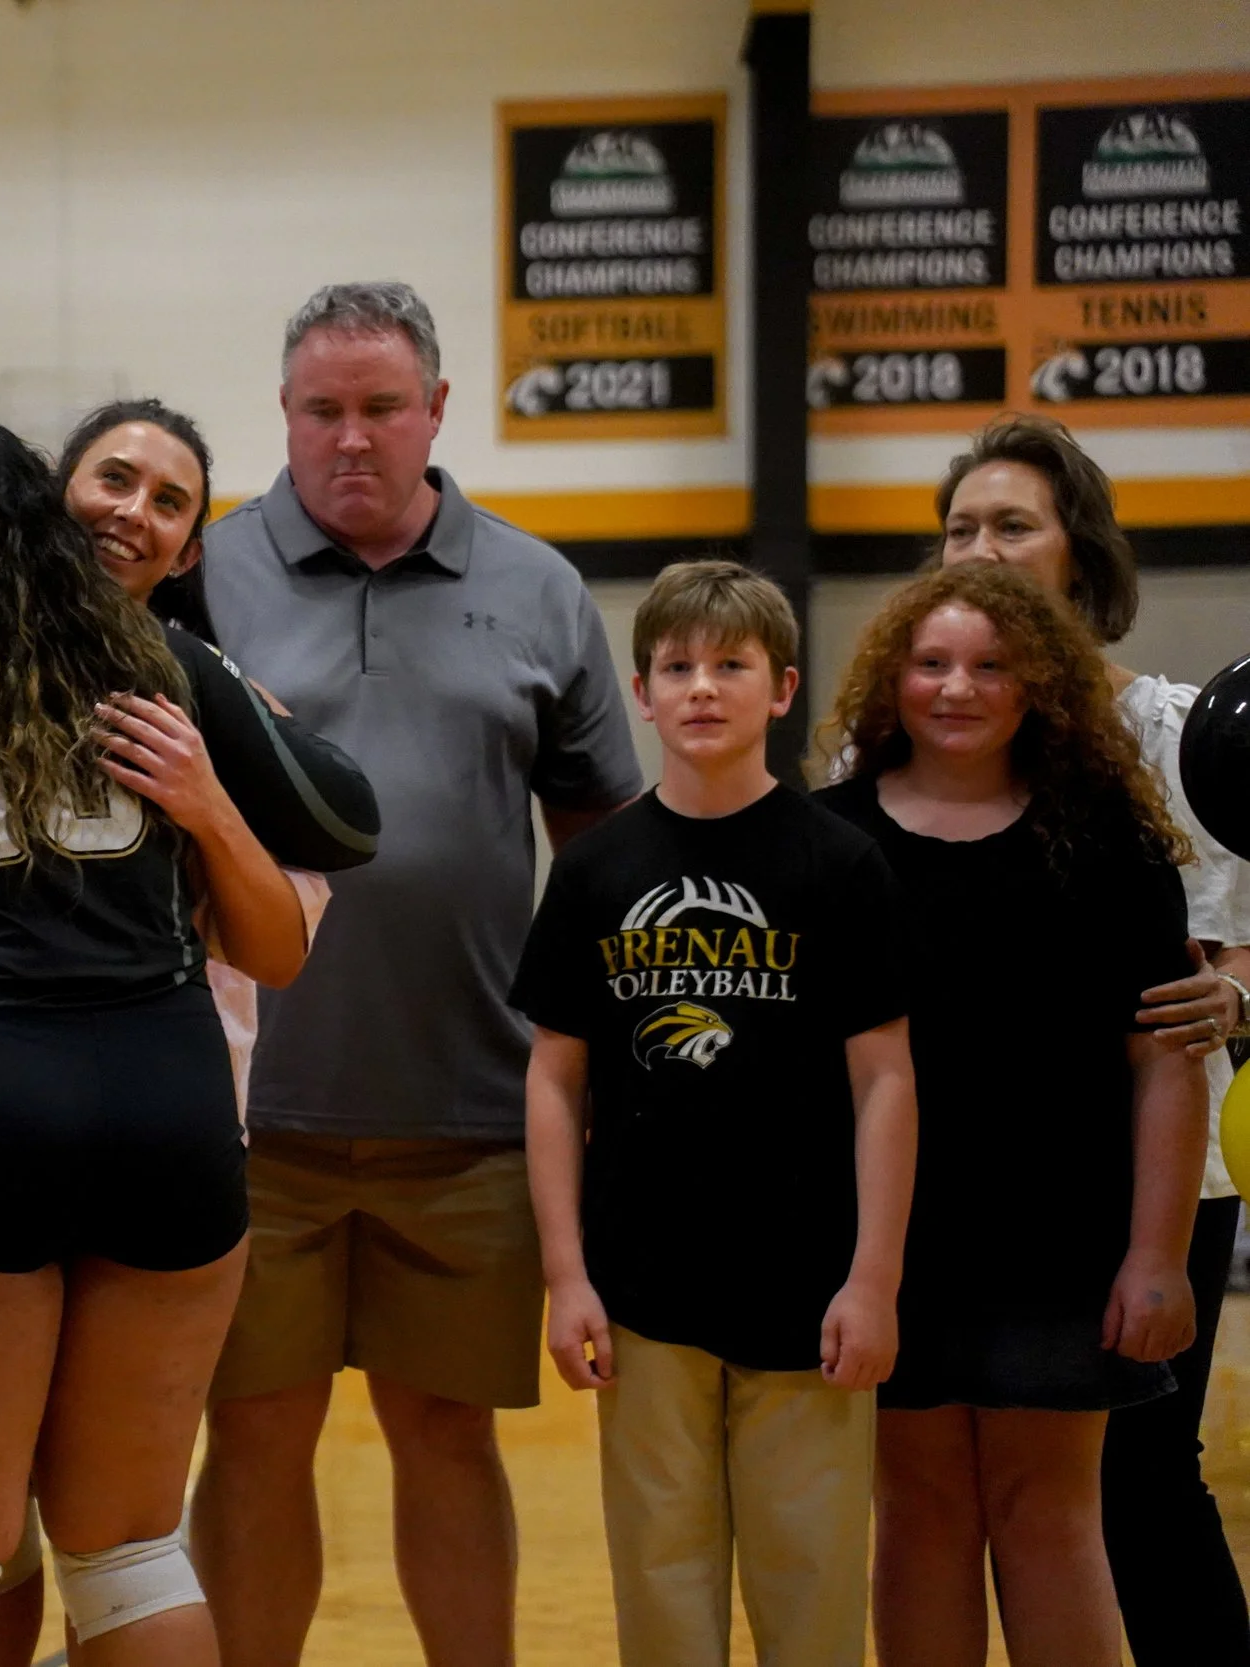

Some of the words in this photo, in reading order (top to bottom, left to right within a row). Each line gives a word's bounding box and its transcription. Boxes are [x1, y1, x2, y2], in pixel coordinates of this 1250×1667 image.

[520, 216, 703, 259] CONFERENCE
[808, 209, 995, 250] CONFERENCE
[1049, 200, 1240, 242] CONFERENCE
[526, 257, 698, 298] CHAMPIONS
[813, 248, 991, 288] CHAMPIONS
[1054, 239, 1234, 281] CHAMPIONS
[529, 312, 693, 344] SOFTBALL
[1081, 291, 1207, 327] TENNIS
[564, 360, 671, 411] 2021
[852, 352, 963, 402] 2018
[1094, 344, 1206, 395] 2018
[607, 969, 797, 1001] OLLEYBALL
